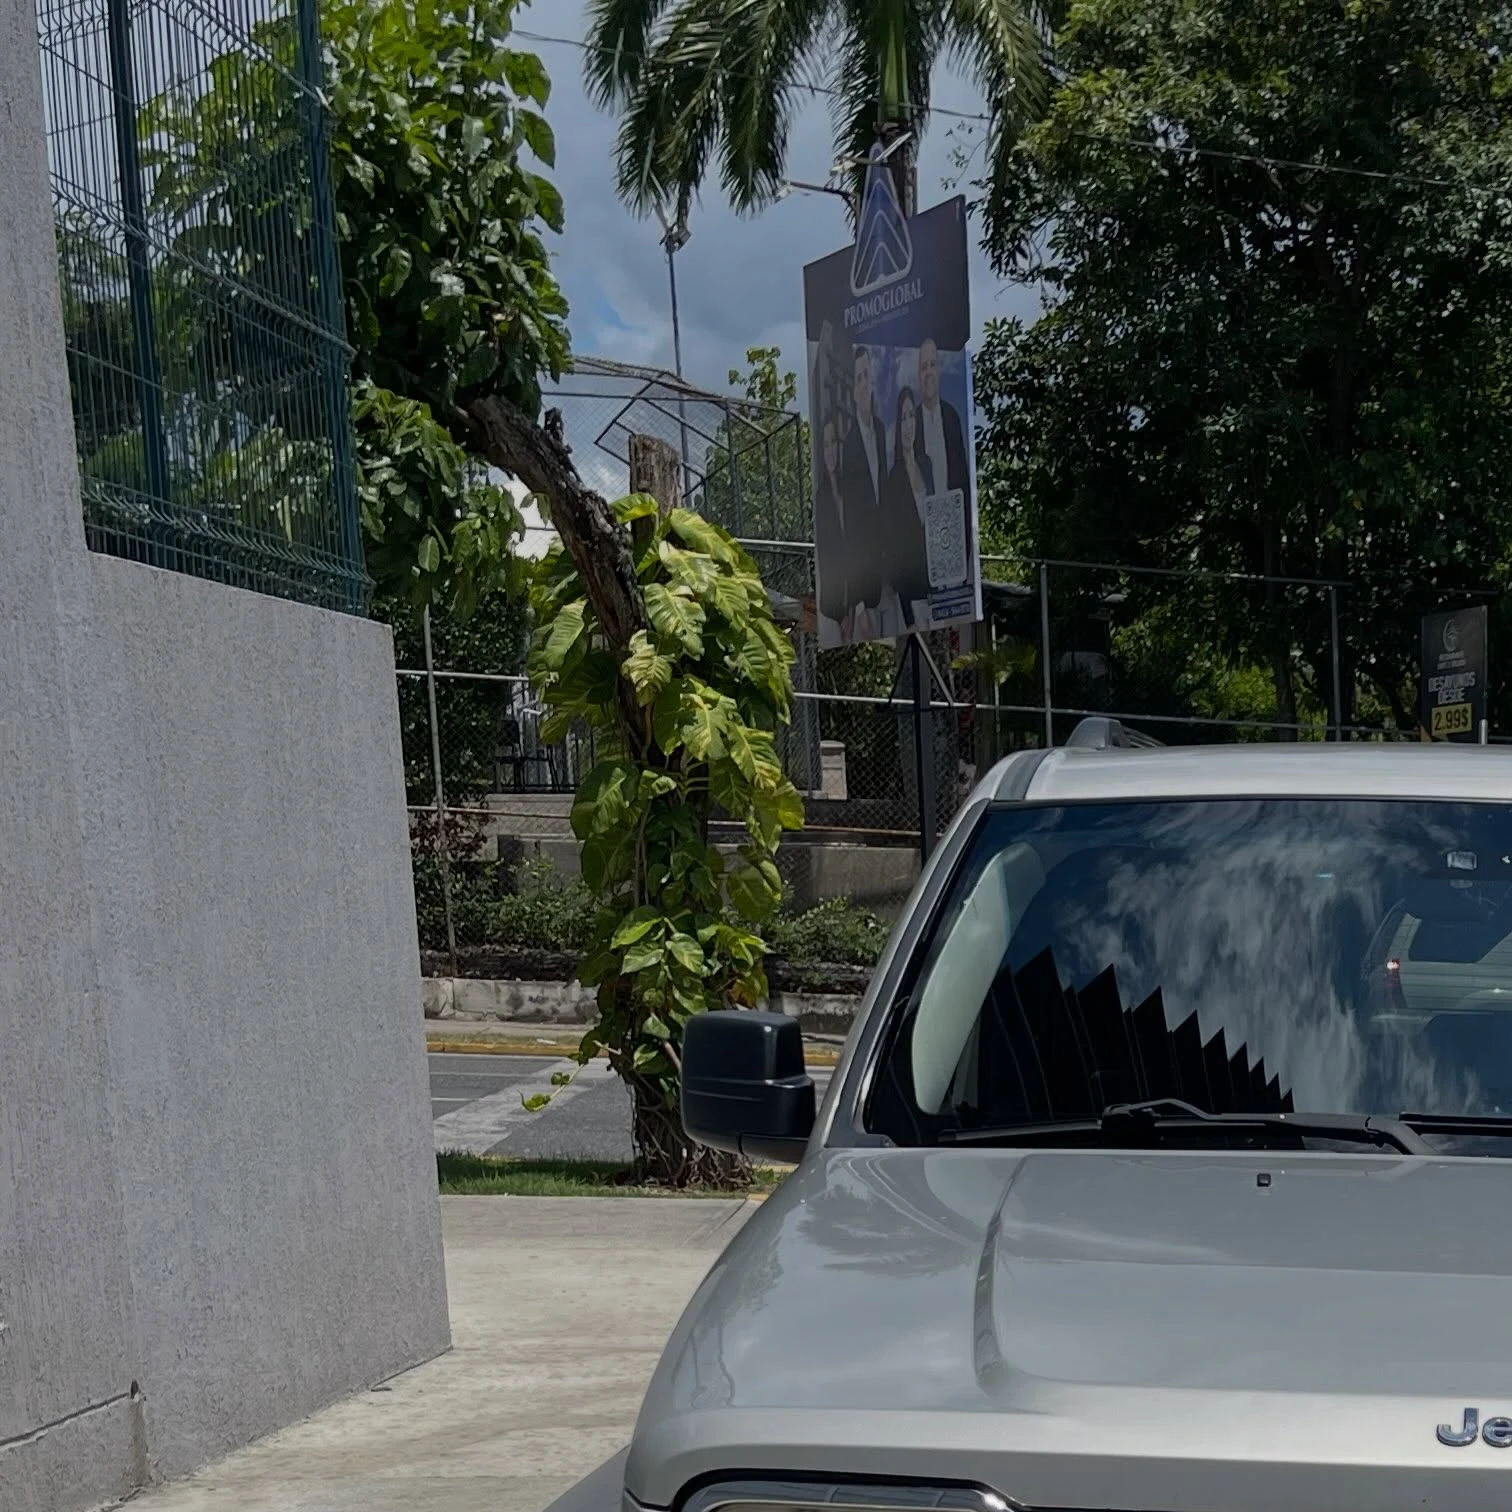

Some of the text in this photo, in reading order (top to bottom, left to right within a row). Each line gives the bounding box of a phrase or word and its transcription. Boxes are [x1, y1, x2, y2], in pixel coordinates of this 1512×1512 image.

[844, 278, 924, 329] PROMOGLOBAL
[1428, 671, 1476, 692] DESAYUNOS
[1438, 687, 1465, 704] DESDE
[1434, 707, 1469, 731] 2.99$
